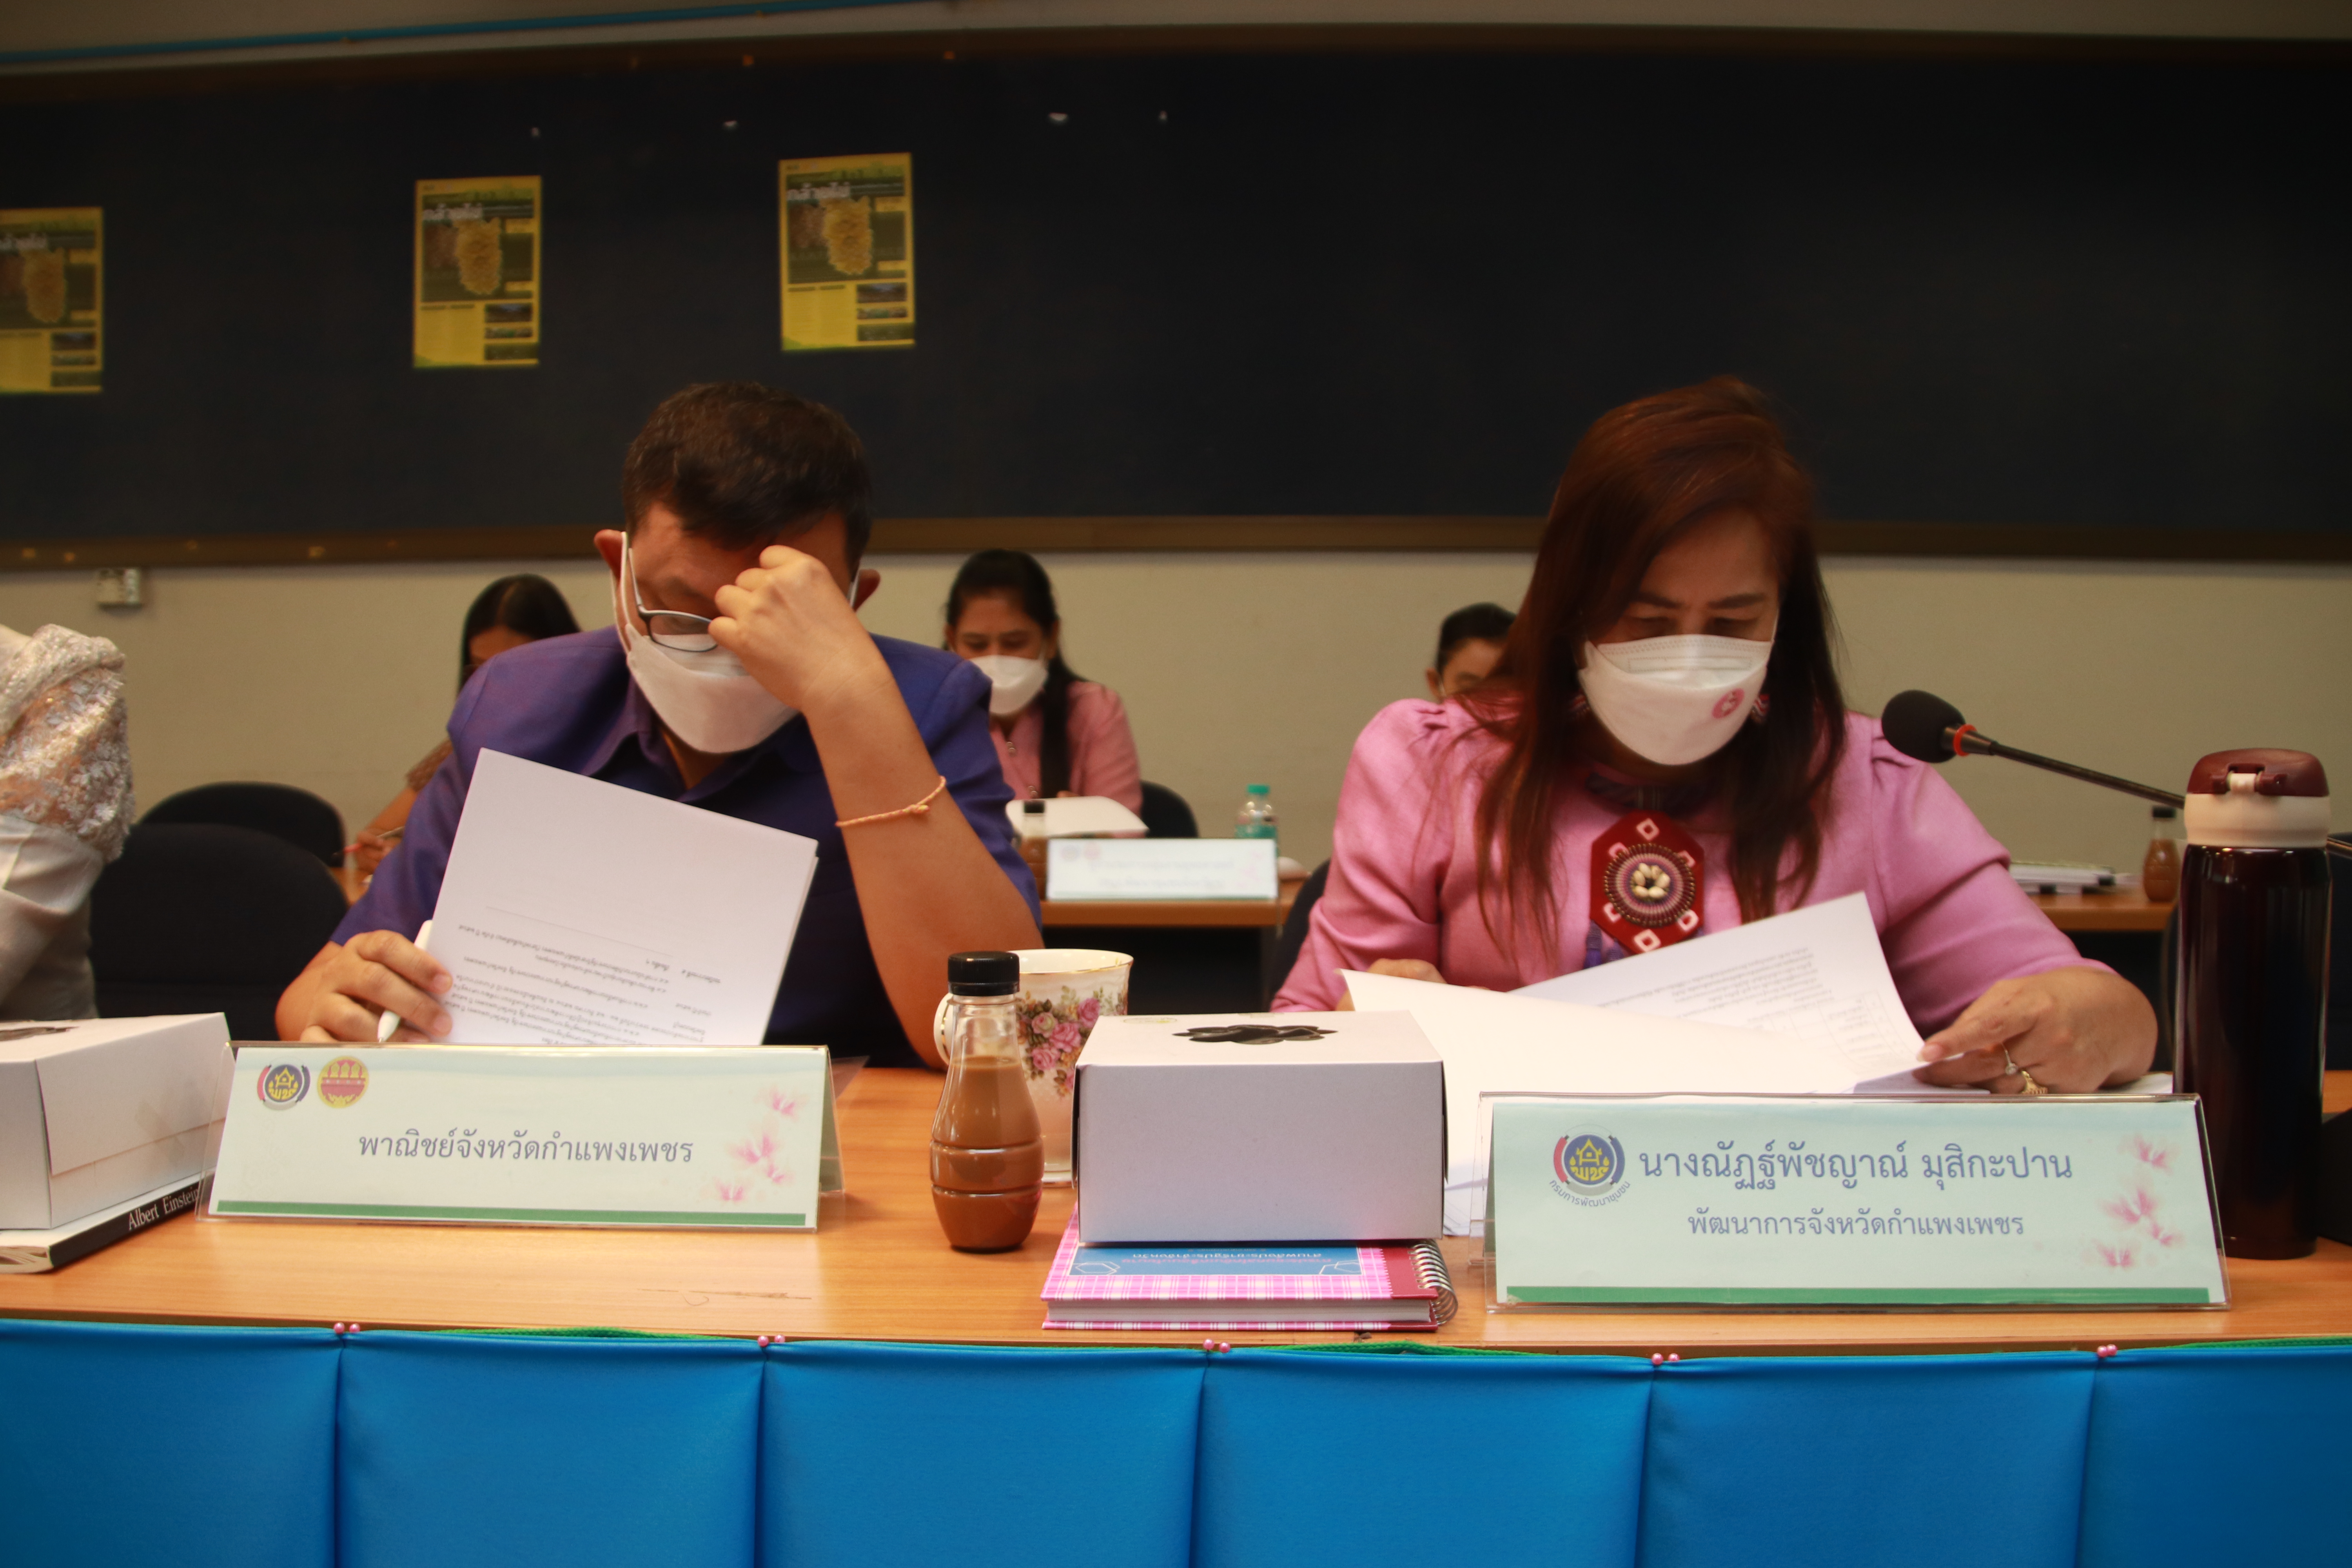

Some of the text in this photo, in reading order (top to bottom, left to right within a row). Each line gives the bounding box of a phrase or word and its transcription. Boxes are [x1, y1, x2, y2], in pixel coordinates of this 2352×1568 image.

[359, 1127, 693, 1162] พาณิชย์จังหวัดกำแพงเพชร
[1639, 1139, 2072, 1191] นางณัฏฐ์พัชญาณ์ มุสิกะปาน
[1549, 1180, 1631, 1207] กรมการพัฒนาชุมชน
[129, 1203, 160, 1231] Albert
[1688, 1207, 2024, 1234] พัฒนาการจังหวัดกำแพงเพชร
